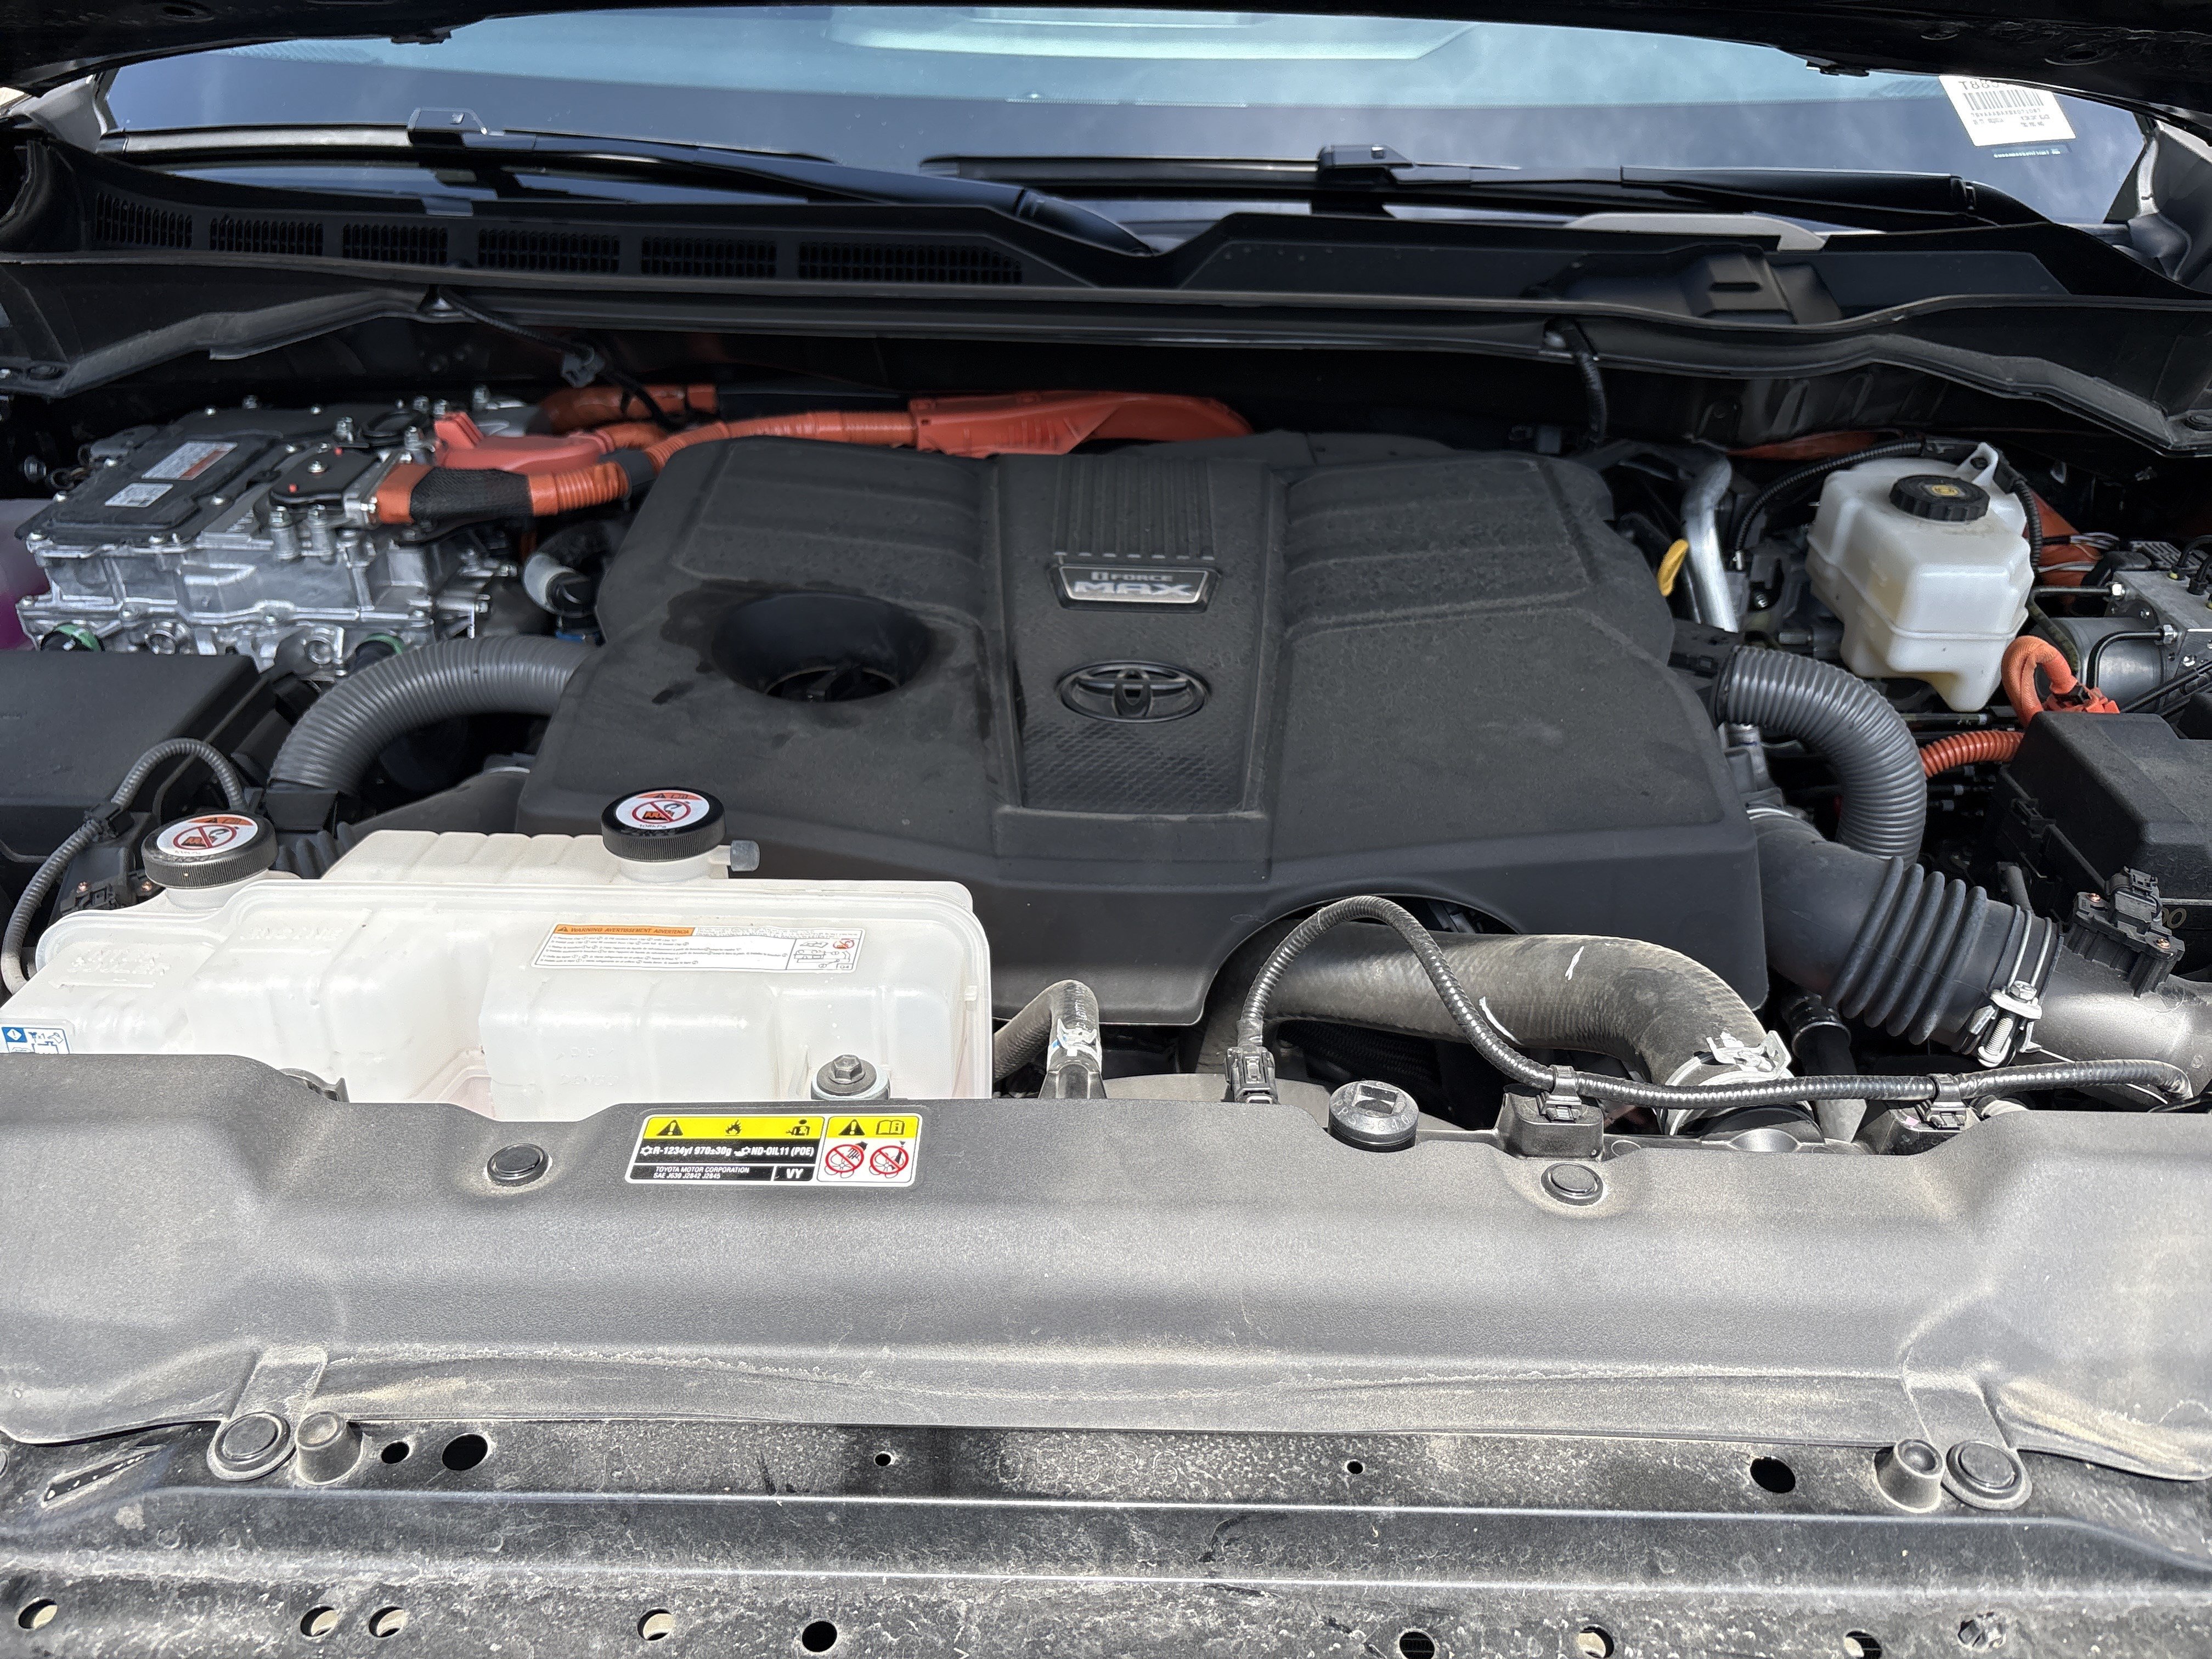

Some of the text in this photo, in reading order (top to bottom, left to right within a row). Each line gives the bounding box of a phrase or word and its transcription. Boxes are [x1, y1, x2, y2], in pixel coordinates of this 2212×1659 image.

[1074, 581, 1193, 596] MAX
[652, 1146, 814, 1157] R-1234yf 970±30g ND-OIL11 (POE)
[786, 1168, 804, 1178] VY
